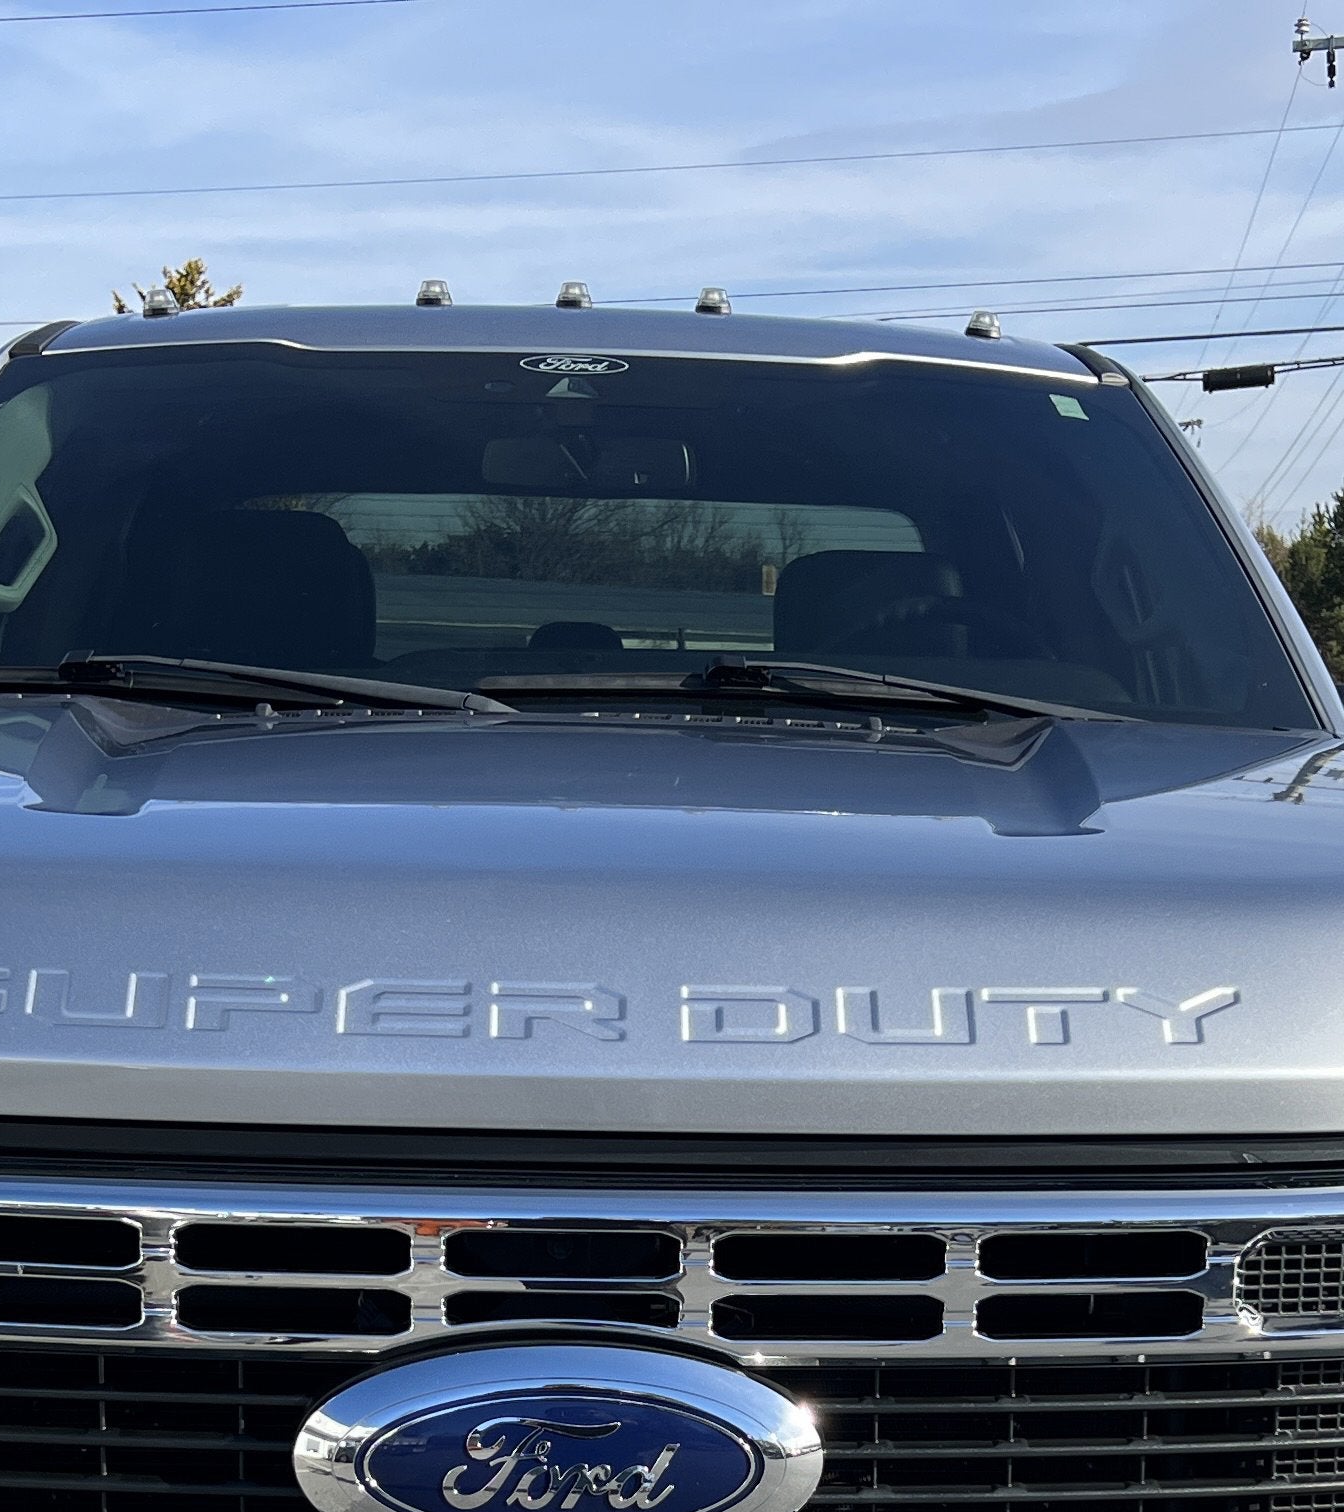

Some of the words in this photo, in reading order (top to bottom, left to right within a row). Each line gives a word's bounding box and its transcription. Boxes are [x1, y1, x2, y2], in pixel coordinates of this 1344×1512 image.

[538, 356, 610, 372] Ford
[680, 985, 1241, 1046] DUTY
[442, 1415, 681, 1511] Ford
